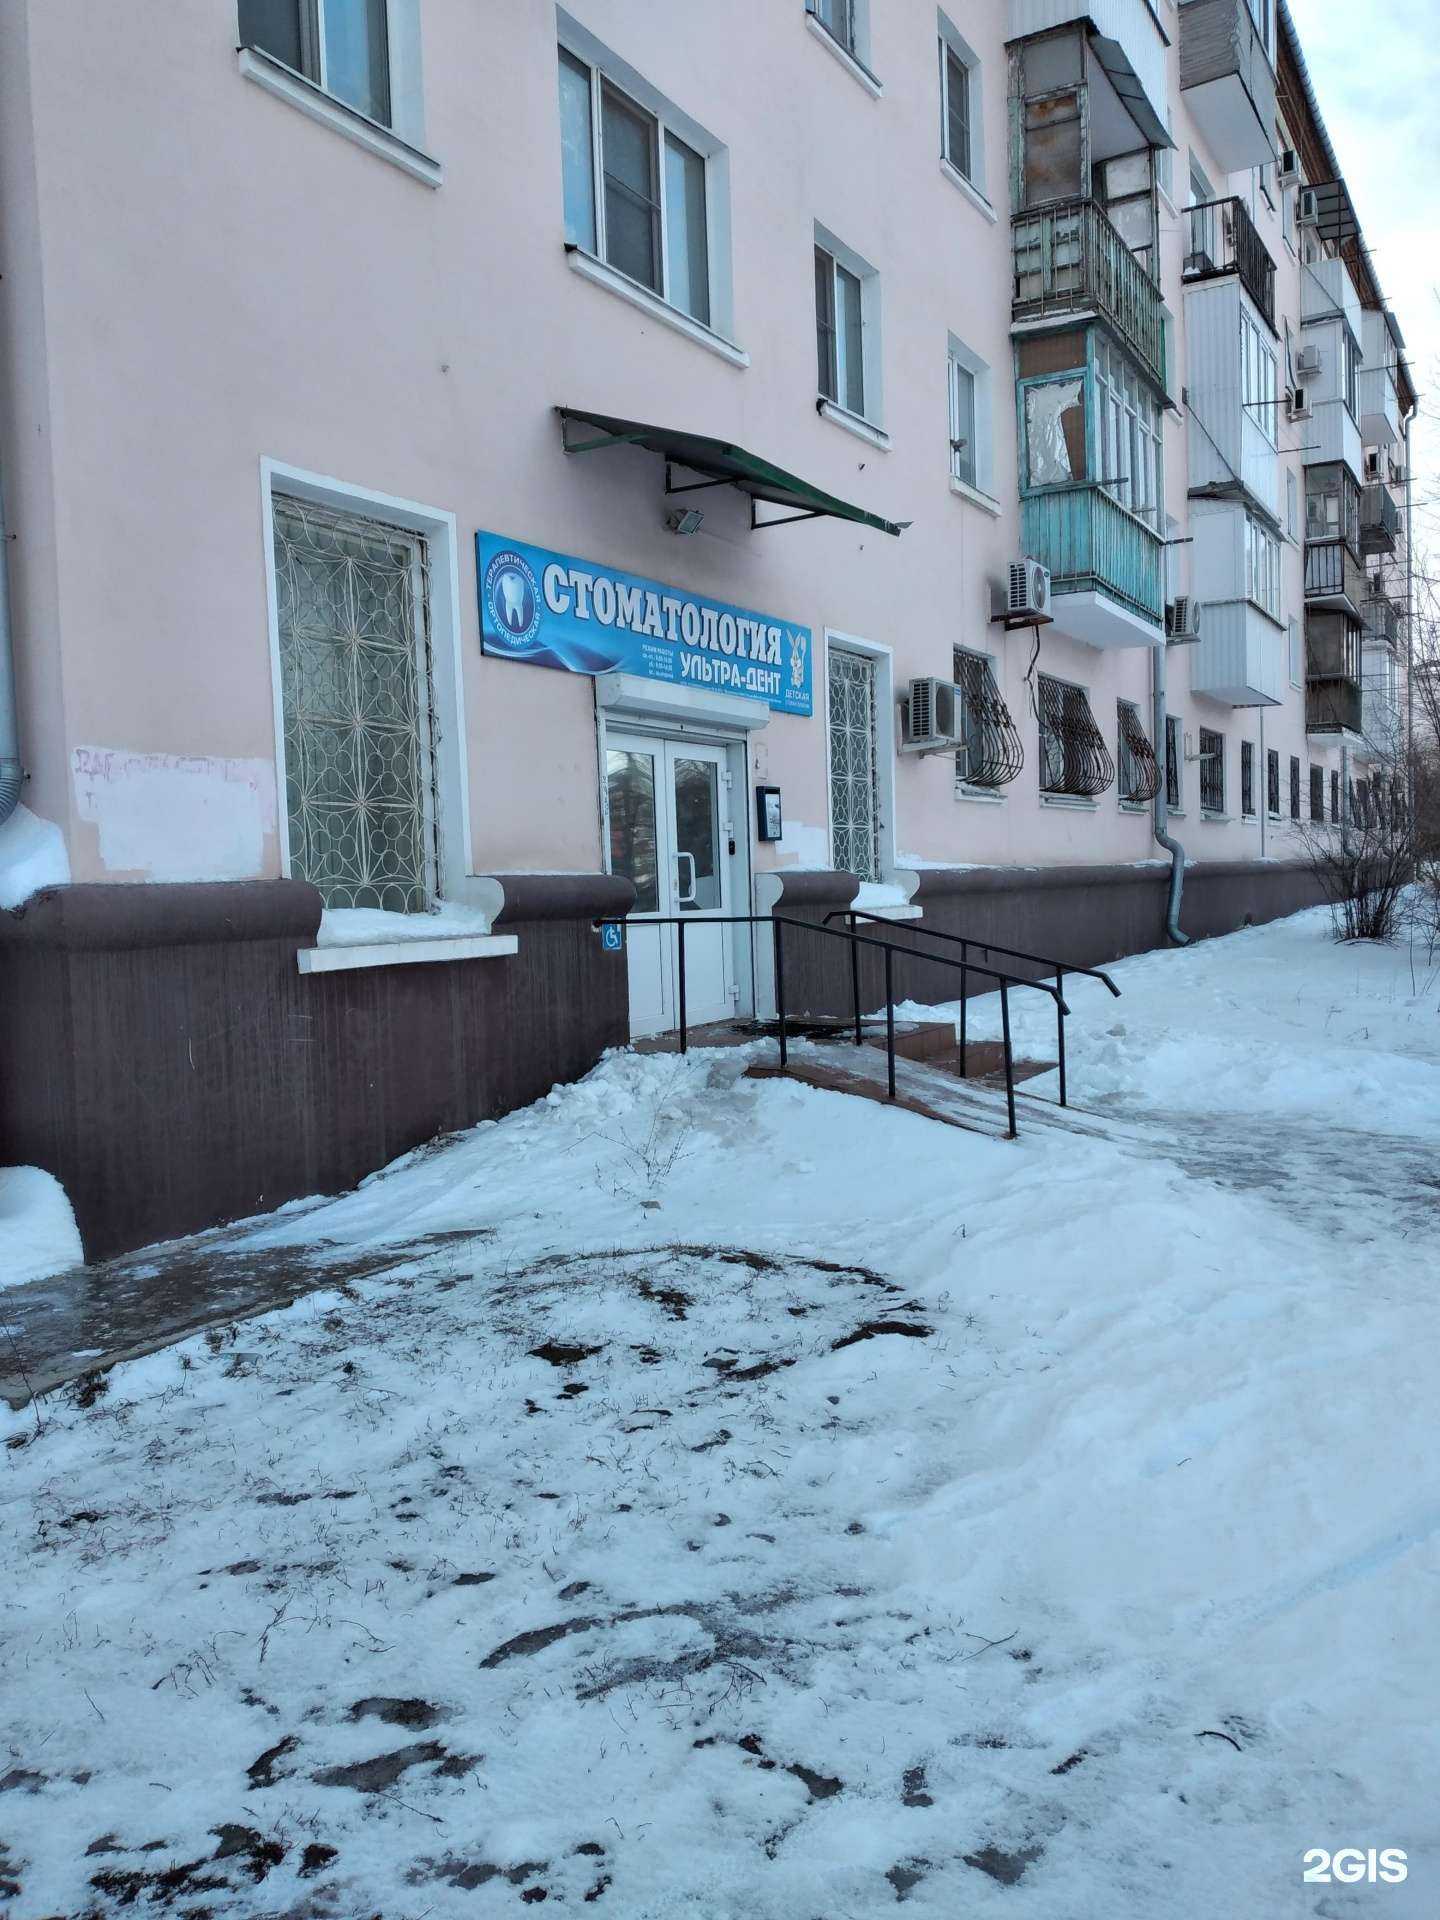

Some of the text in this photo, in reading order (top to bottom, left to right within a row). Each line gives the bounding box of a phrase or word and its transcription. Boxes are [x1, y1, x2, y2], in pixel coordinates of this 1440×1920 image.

[486, 554, 541, 603] ТЕРАПЕВТИЧЕСКАЯ
[488, 601, 541, 645] ОРТОПЕДИЧЕСКАЯ
[542, 563, 782, 666] СТОМАТОЛОГИЯ
[680, 651, 781, 695] УЛЬТРА-ДЕНТ
